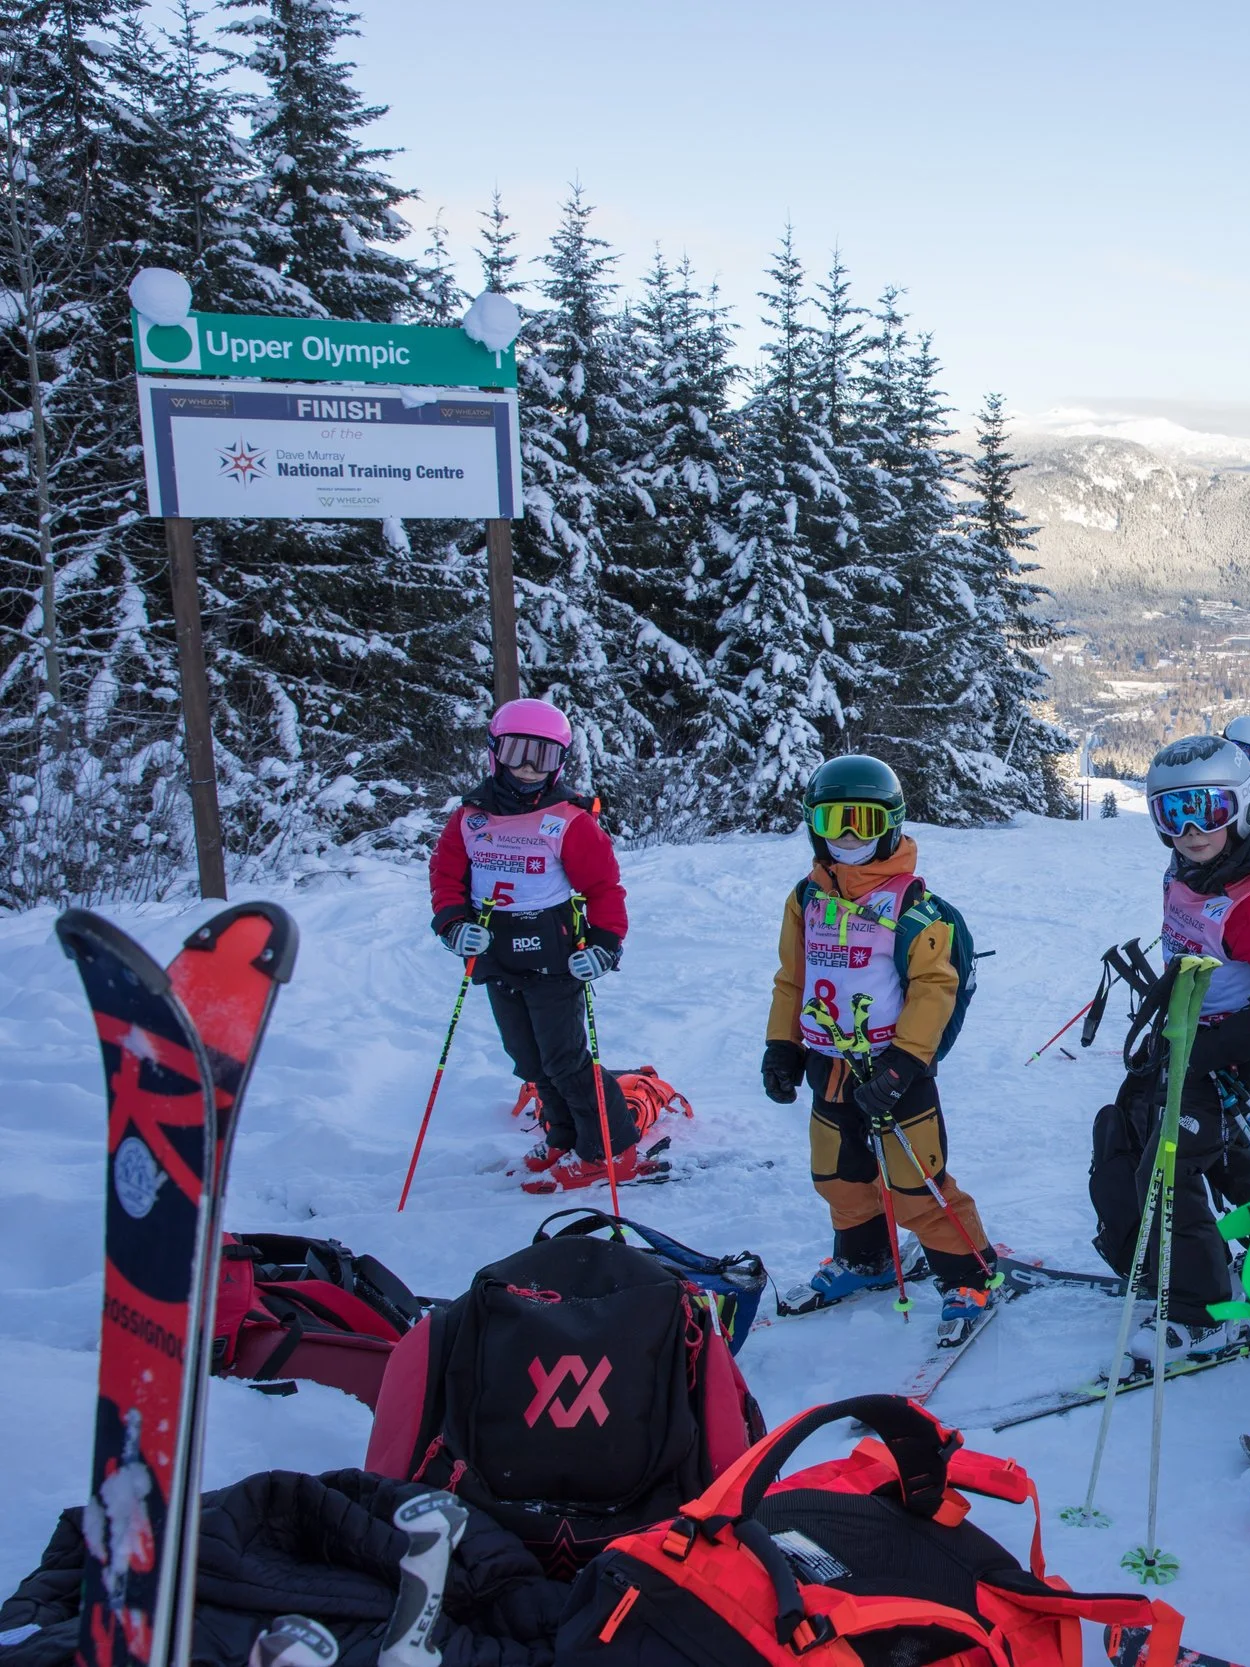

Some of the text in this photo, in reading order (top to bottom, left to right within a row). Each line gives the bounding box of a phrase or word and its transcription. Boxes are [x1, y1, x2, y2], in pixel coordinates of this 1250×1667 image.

[206, 330, 411, 370] Upper Olympic
[297, 399, 382, 421] FINISH
[455, 408, 491, 417] WHEATON
[321, 428, 363, 440] of the
[276, 449, 345, 463] Dave Murray
[278, 462, 464, 481] National Training Centre
[337, 496, 380, 504] WHEATON
[498, 835, 546, 846] MACKENZIE
[473, 850, 526, 861] WHISTLER
[472, 862, 525, 874] WHISTLER
[492, 881, 515, 907] 5
[1169, 904, 1205, 932] MACKENZIE
[513, 936, 541, 948] RDC
[815, 978, 839, 1022] 8
[830, 1024, 842, 1041] LEKI
[1150, 1167, 1164, 1212] LEKI
[1165, 1185, 1174, 1233] LEKI
[1190, 1323, 1224, 1348] HEAD
[402, 1497, 456, 1521] LEKI
[409, 1593, 441, 1648] LEKI
